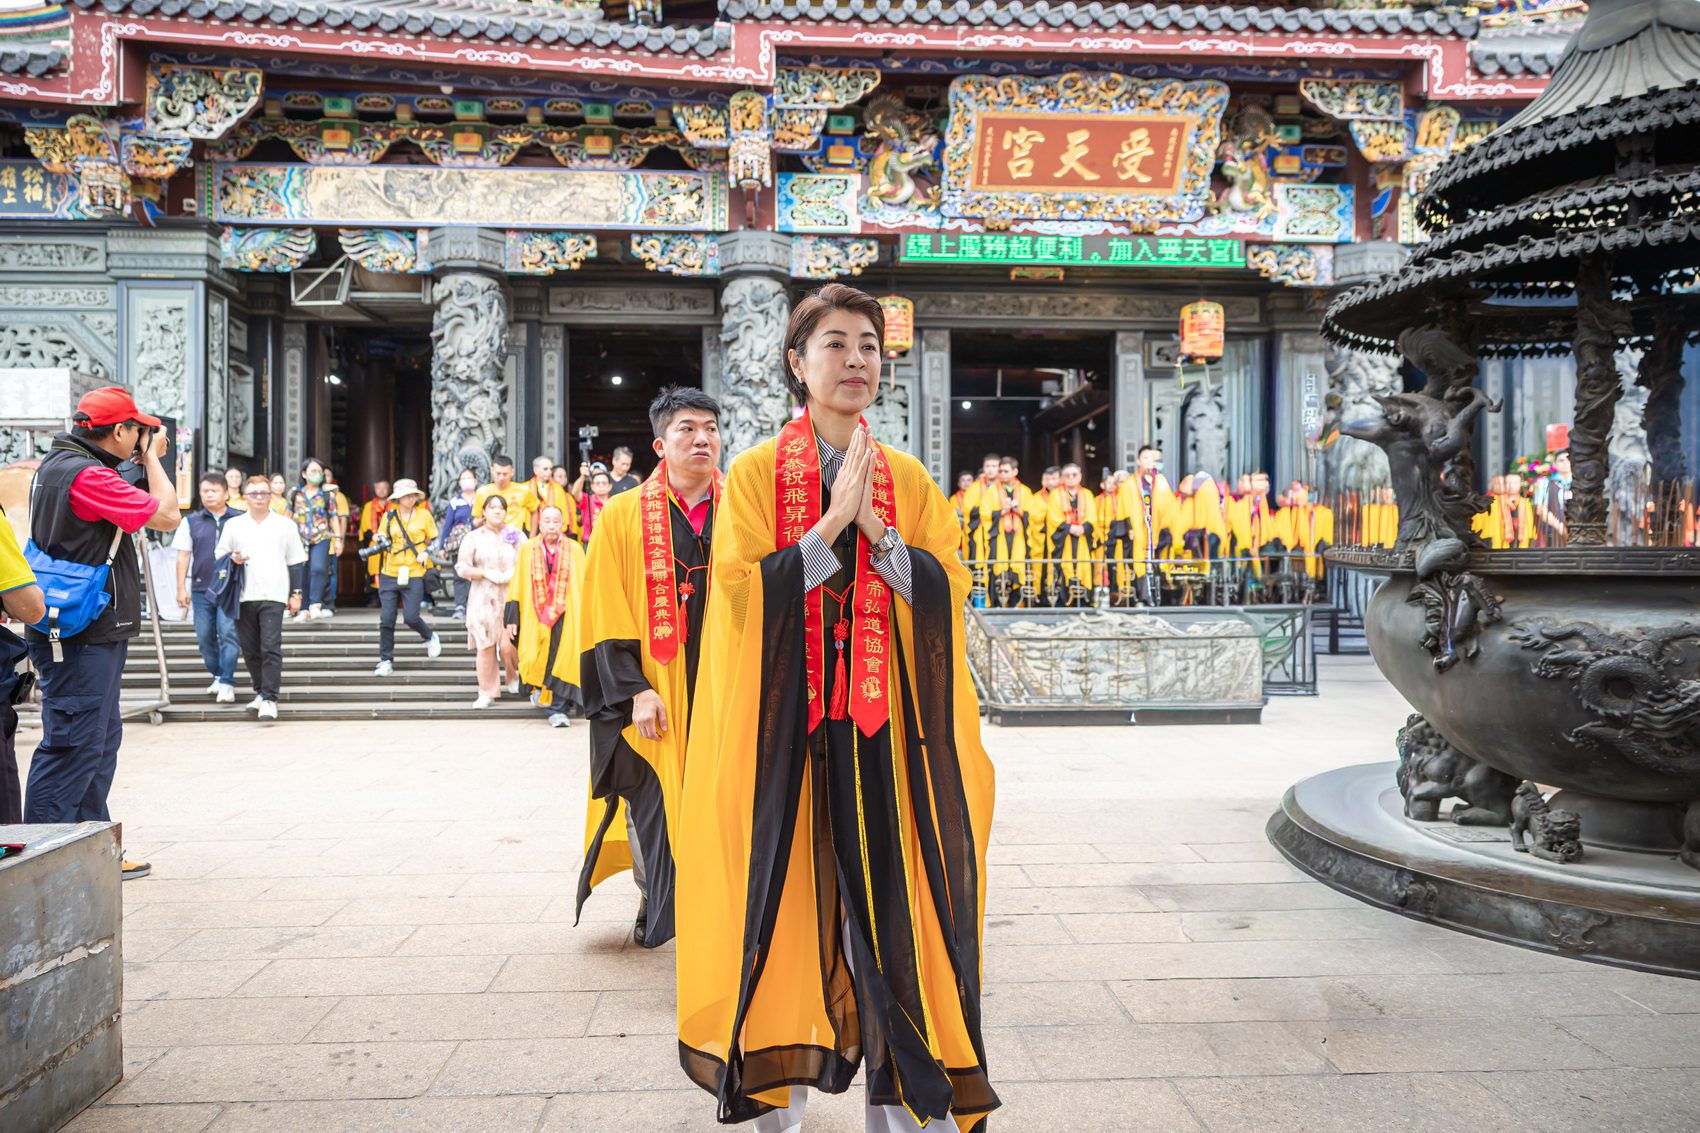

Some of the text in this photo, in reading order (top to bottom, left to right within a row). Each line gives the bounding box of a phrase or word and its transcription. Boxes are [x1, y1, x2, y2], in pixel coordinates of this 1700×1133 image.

[1002, 126, 1155, 183] 受天宮
[781, 457, 808, 543] 恭祝飛昇得
[645, 480, 671, 621] 恭祝飛昇得道全國聯合慶典
[863, 571, 885, 674] 帝弘道協會
